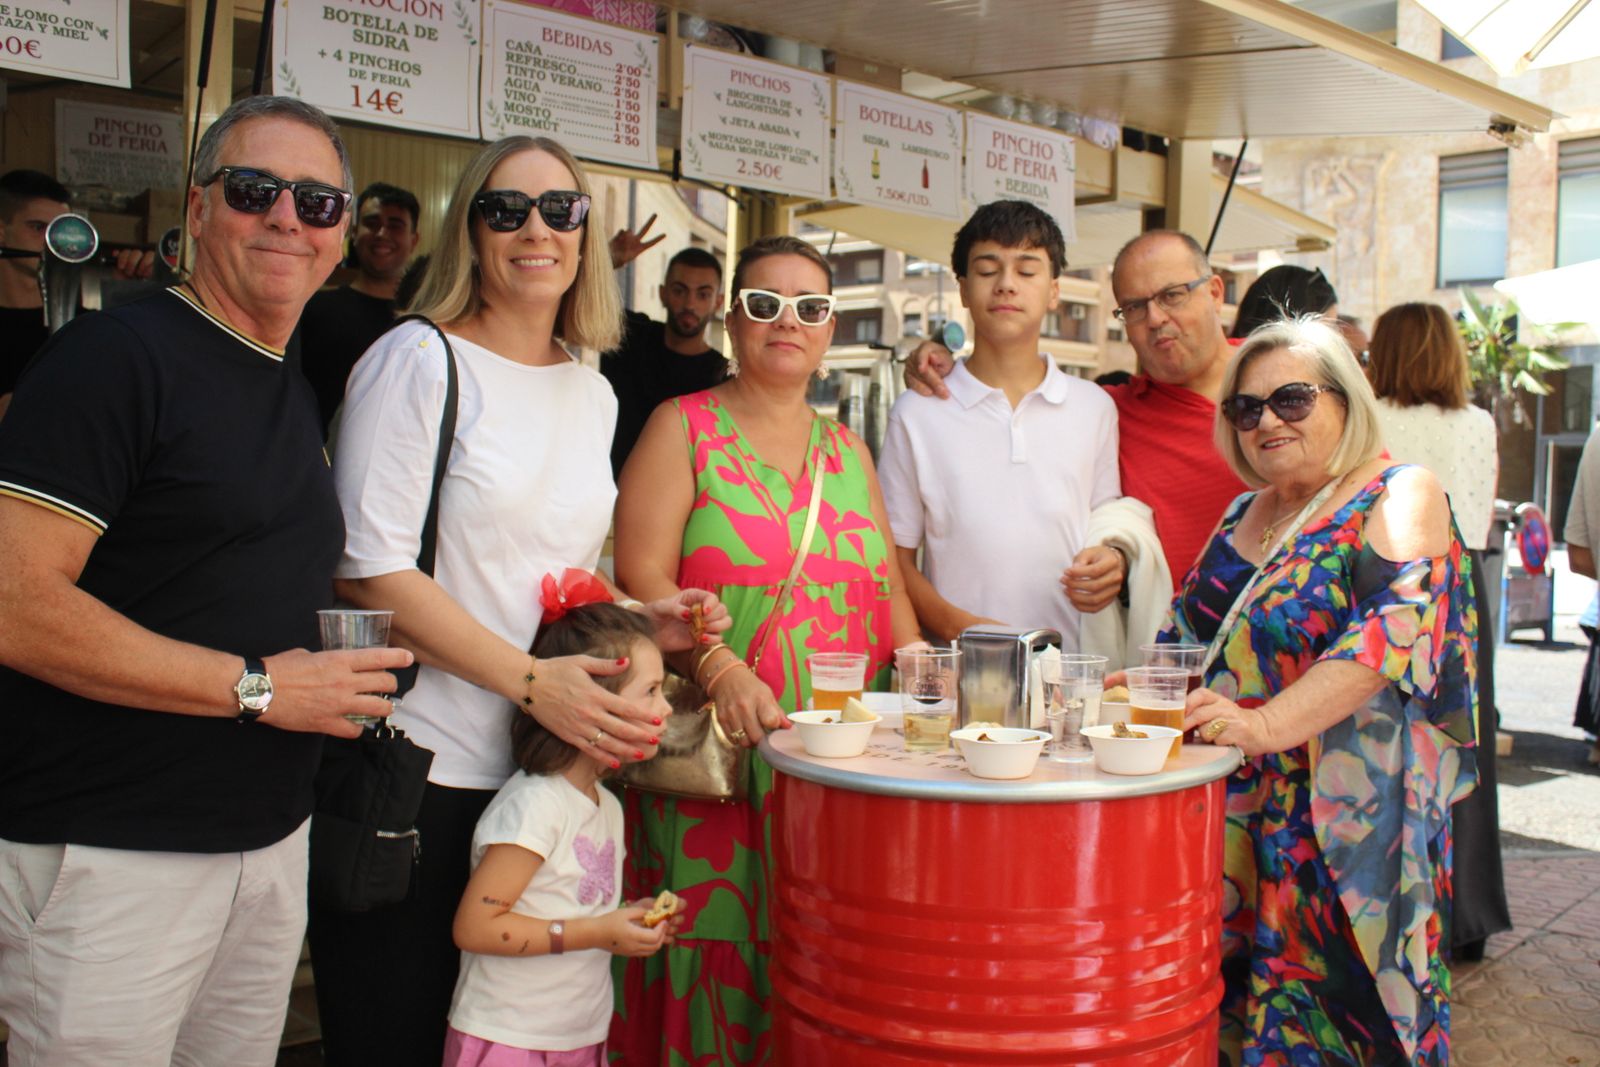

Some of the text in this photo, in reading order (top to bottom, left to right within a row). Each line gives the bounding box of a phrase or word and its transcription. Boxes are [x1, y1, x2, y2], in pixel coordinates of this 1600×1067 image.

[0, 4, 94, 31] E LOMO CON
[322, 6, 439, 41] BOTELLA DE
[38, 23, 48, 33] Y
[53, 26, 90, 41] MIEL
[352, 29, 410, 52] SIDRA
[542, 27, 613, 56] BEBIDAS
[0, 36, 42, 58] 0€
[505, 39, 543, 56] CAÑA
[333, 48, 343, 62] 4
[348, 52, 422, 76] PINCHOS
[505, 51, 577, 75] REFRESCO
[348, 68, 411, 88] DE FERIA
[504, 76, 541, 93] AGUA
[505, 64, 546, 81] TINTO
[550, 73, 602, 93] VERANO
[730, 69, 791, 94] PINCHOS
[351, 84, 404, 114] 14€
[504, 88, 536, 103] VINO
[727, 88, 793, 109] BROCHETA DE
[504, 100, 551, 119] MOSTO
[859, 104, 934, 136] BOTELLAS
[94, 117, 162, 137] PINCHO
[504, 113, 560, 132] VERMUT
[729, 116, 791, 137] JETA ASADA
[88, 133, 168, 154] DE FERIA
[707, 131, 753, 146] MONTADO
[754, 139, 767, 149] DE
[768, 142, 793, 154] LOMO
[992, 131, 1054, 160] PINCHO
[781, 152, 788, 161] Y
[986, 150, 1058, 183] DE FERIA
[1005, 178, 1049, 199] BEBIDA
